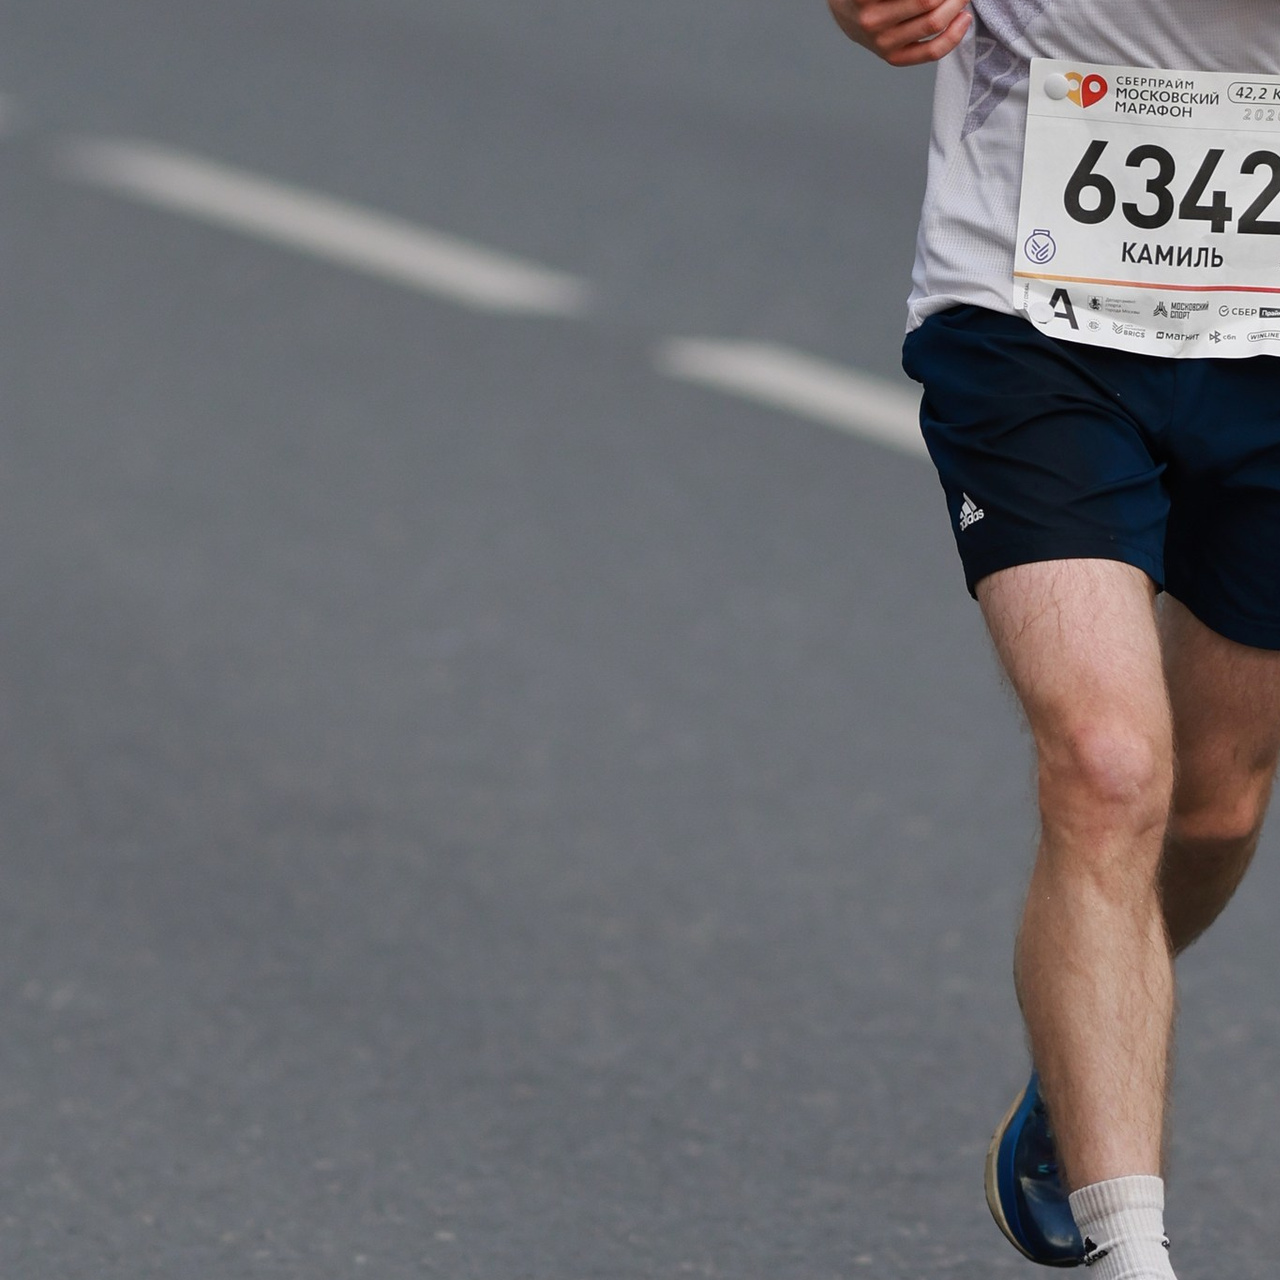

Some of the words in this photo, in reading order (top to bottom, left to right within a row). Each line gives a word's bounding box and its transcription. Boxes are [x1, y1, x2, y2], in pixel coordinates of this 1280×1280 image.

[1116, 76, 1194, 90] СБЕРПРАЙМ
[1116, 88, 1219, 105] МОСКОВСКИЙ
[1235, 86, 1267, 101] 42,2
[1115, 101, 1193, 118] МАРАФОН
[1121, 242, 1224, 268] КАМИЛЬ
[1170, 301, 1209, 311] МОСКОВСКИЙ
[1170, 310, 1190, 319] СПОРТ
[1231, 307, 1257, 316] СБЕР
[1123, 330, 1146, 338] BRICS
[1165, 332, 1200, 341] магнит
[1250, 332, 1280, 340] WINLINE
